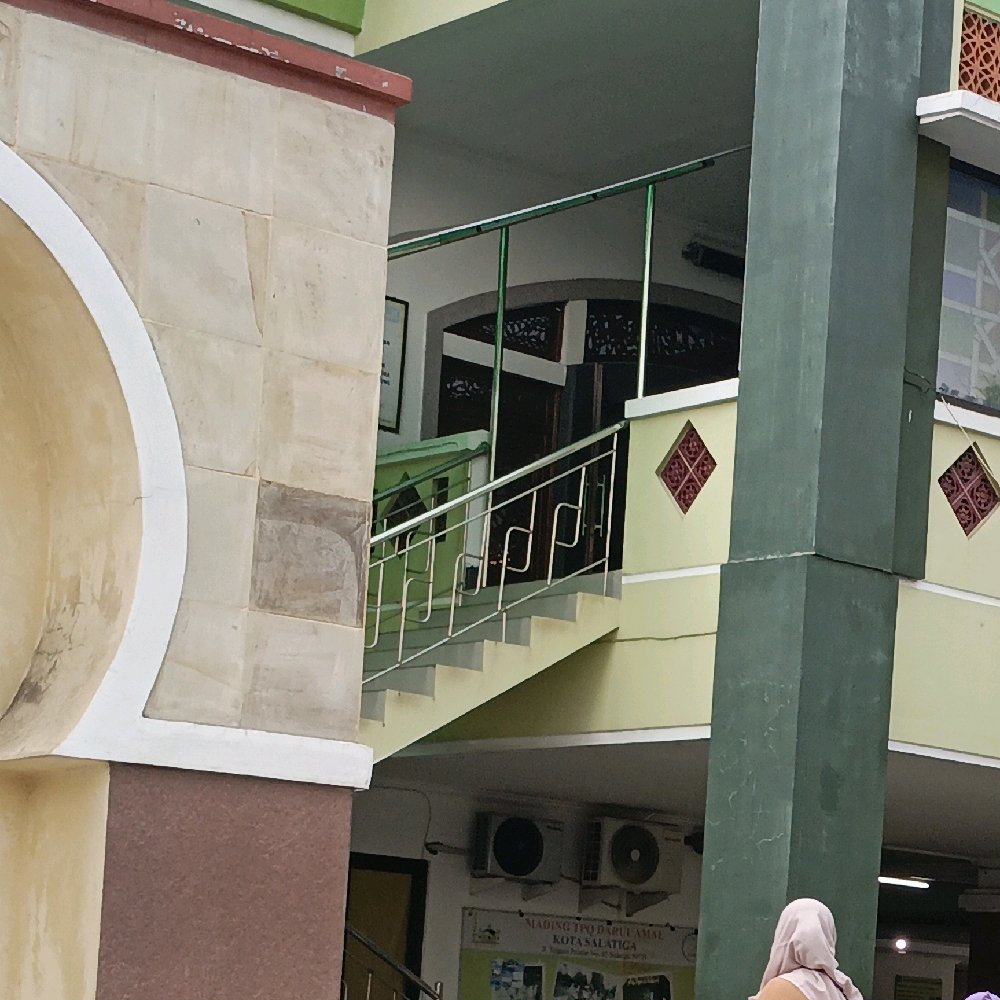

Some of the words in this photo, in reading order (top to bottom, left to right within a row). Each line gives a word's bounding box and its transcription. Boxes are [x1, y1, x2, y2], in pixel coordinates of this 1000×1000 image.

[525, 918, 570, 932] MADING
[634, 927, 664, 940] AMAL
[553, 934, 583, 947] KOTA
[585, 937, 637, 951] SALATIGA
